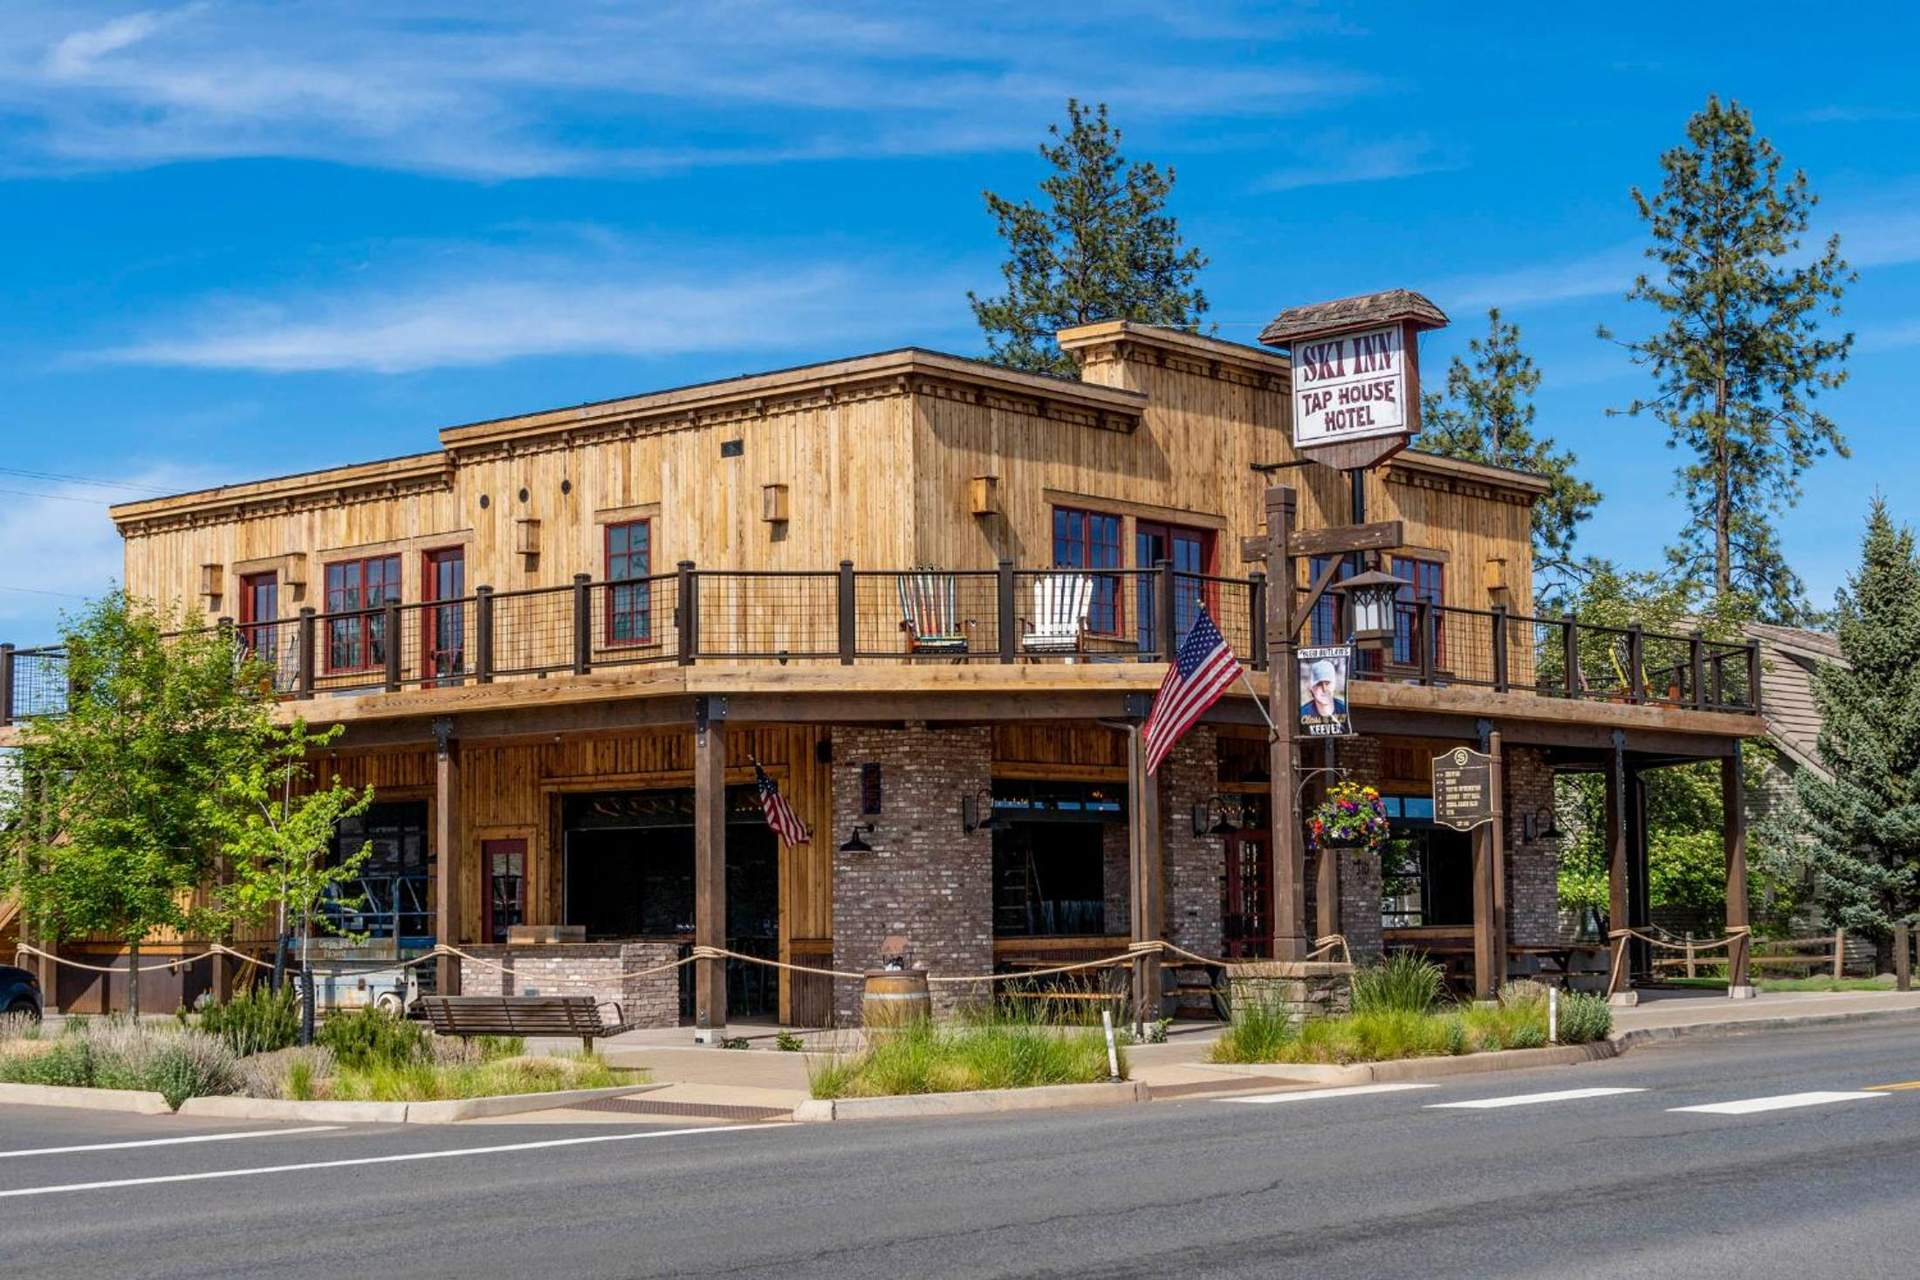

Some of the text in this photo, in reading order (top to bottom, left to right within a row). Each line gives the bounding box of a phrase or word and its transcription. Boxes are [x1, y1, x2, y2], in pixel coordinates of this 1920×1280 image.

[1302, 331, 1393, 383] SKI INN
[1302, 380, 1396, 417] TAP HOUSE
[1324, 405, 1375, 432] HOTEL
